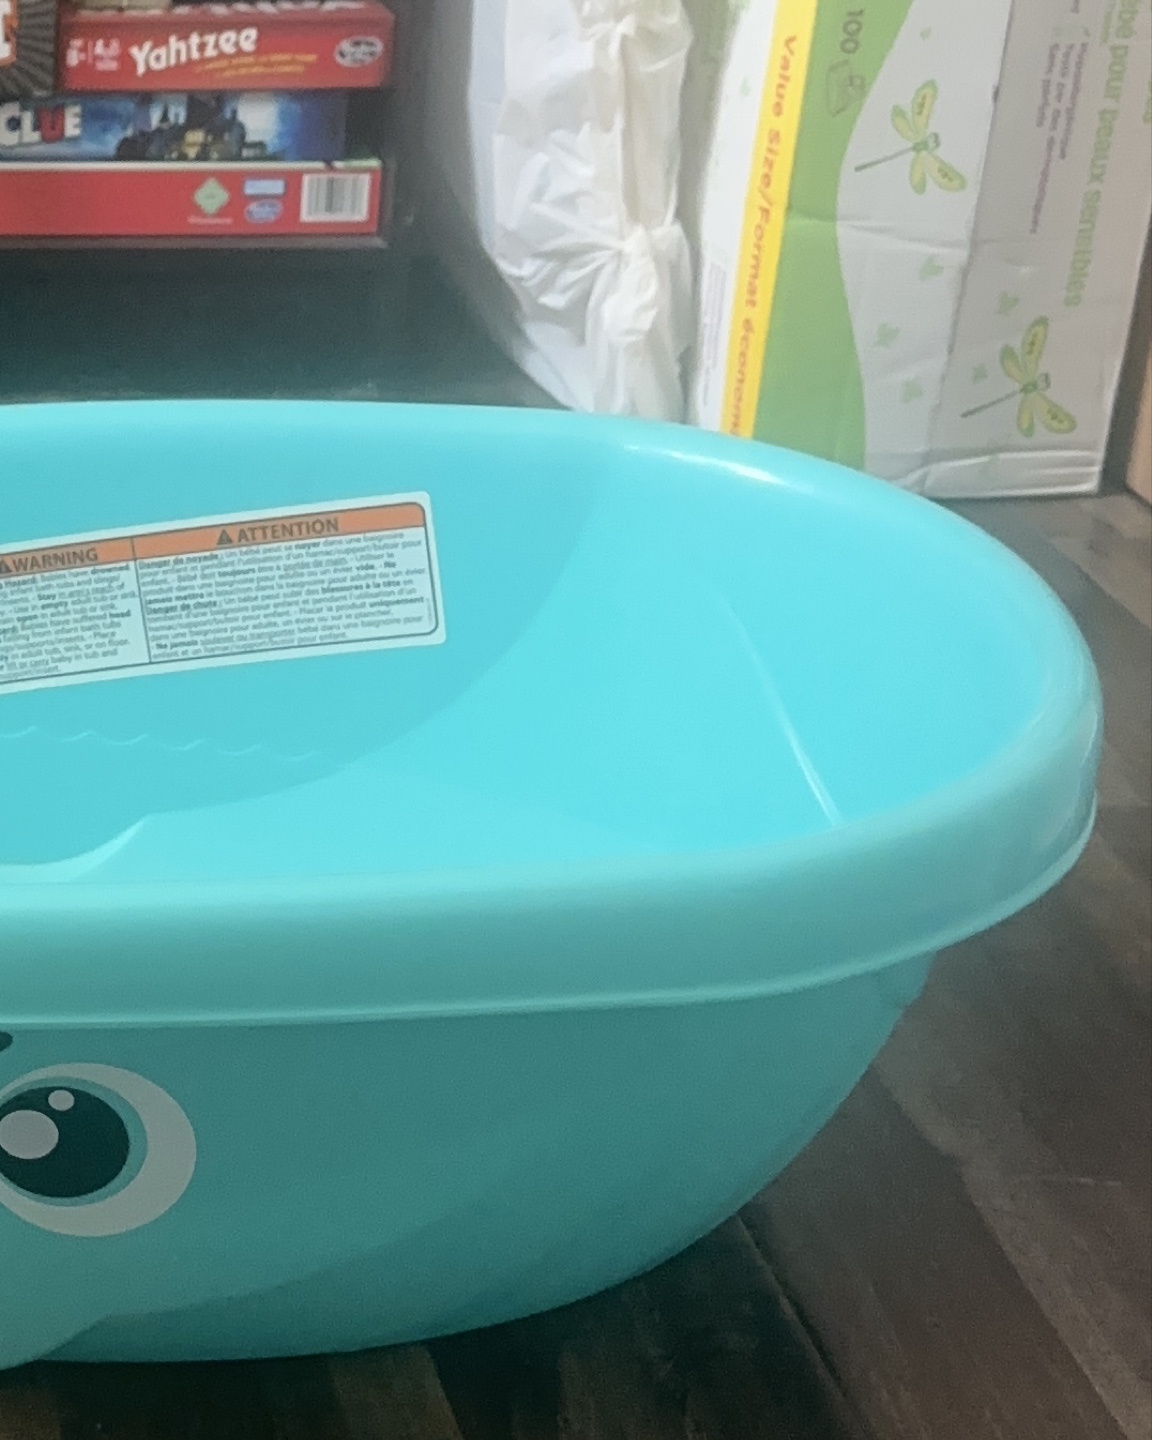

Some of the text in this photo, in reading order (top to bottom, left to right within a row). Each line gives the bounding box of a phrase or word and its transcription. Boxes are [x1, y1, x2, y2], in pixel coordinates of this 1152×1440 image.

[128, 26, 259, 78] Yahtzee
[839, 9, 865, 55] 100
[772, 35, 797, 118] Value
[237, 517, 339, 543] ATTENTION
[12, 547, 99, 573] WARNING
